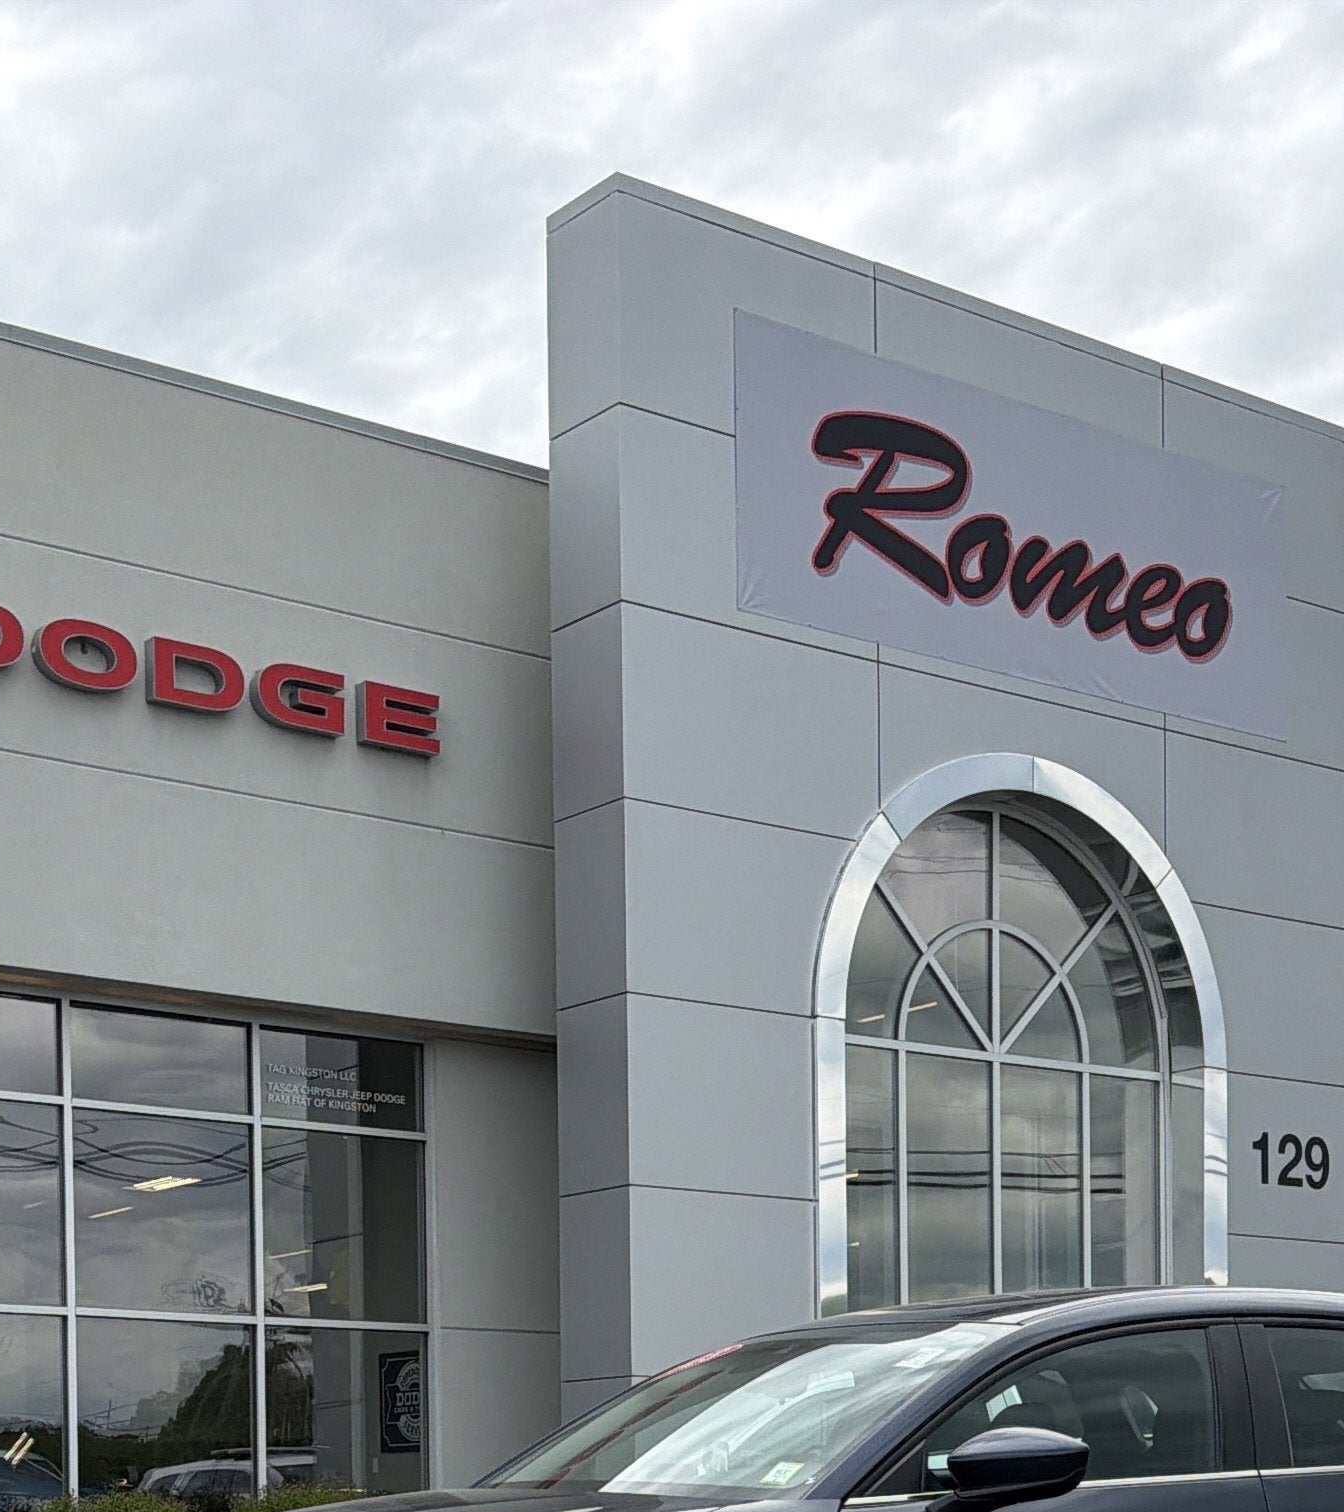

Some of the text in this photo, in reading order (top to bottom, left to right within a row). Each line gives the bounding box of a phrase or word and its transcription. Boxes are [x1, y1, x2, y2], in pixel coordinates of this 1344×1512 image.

[811, 411, 1233, 663] Romeo
[289, 1065, 338, 1080] KINGSTON
[339, 1071, 358, 1081] LLC
[300, 1085, 349, 1099] CHRYSLER
[350, 1090, 373, 1100] JEEP
[373, 1093, 407, 1105] DODGE
[313, 1099, 327, 1108] OF
[328, 1100, 377, 1113] KINGSTON
[1252, 1132, 1331, 1190] 129
[396, 1391, 420, 1406] DOD
